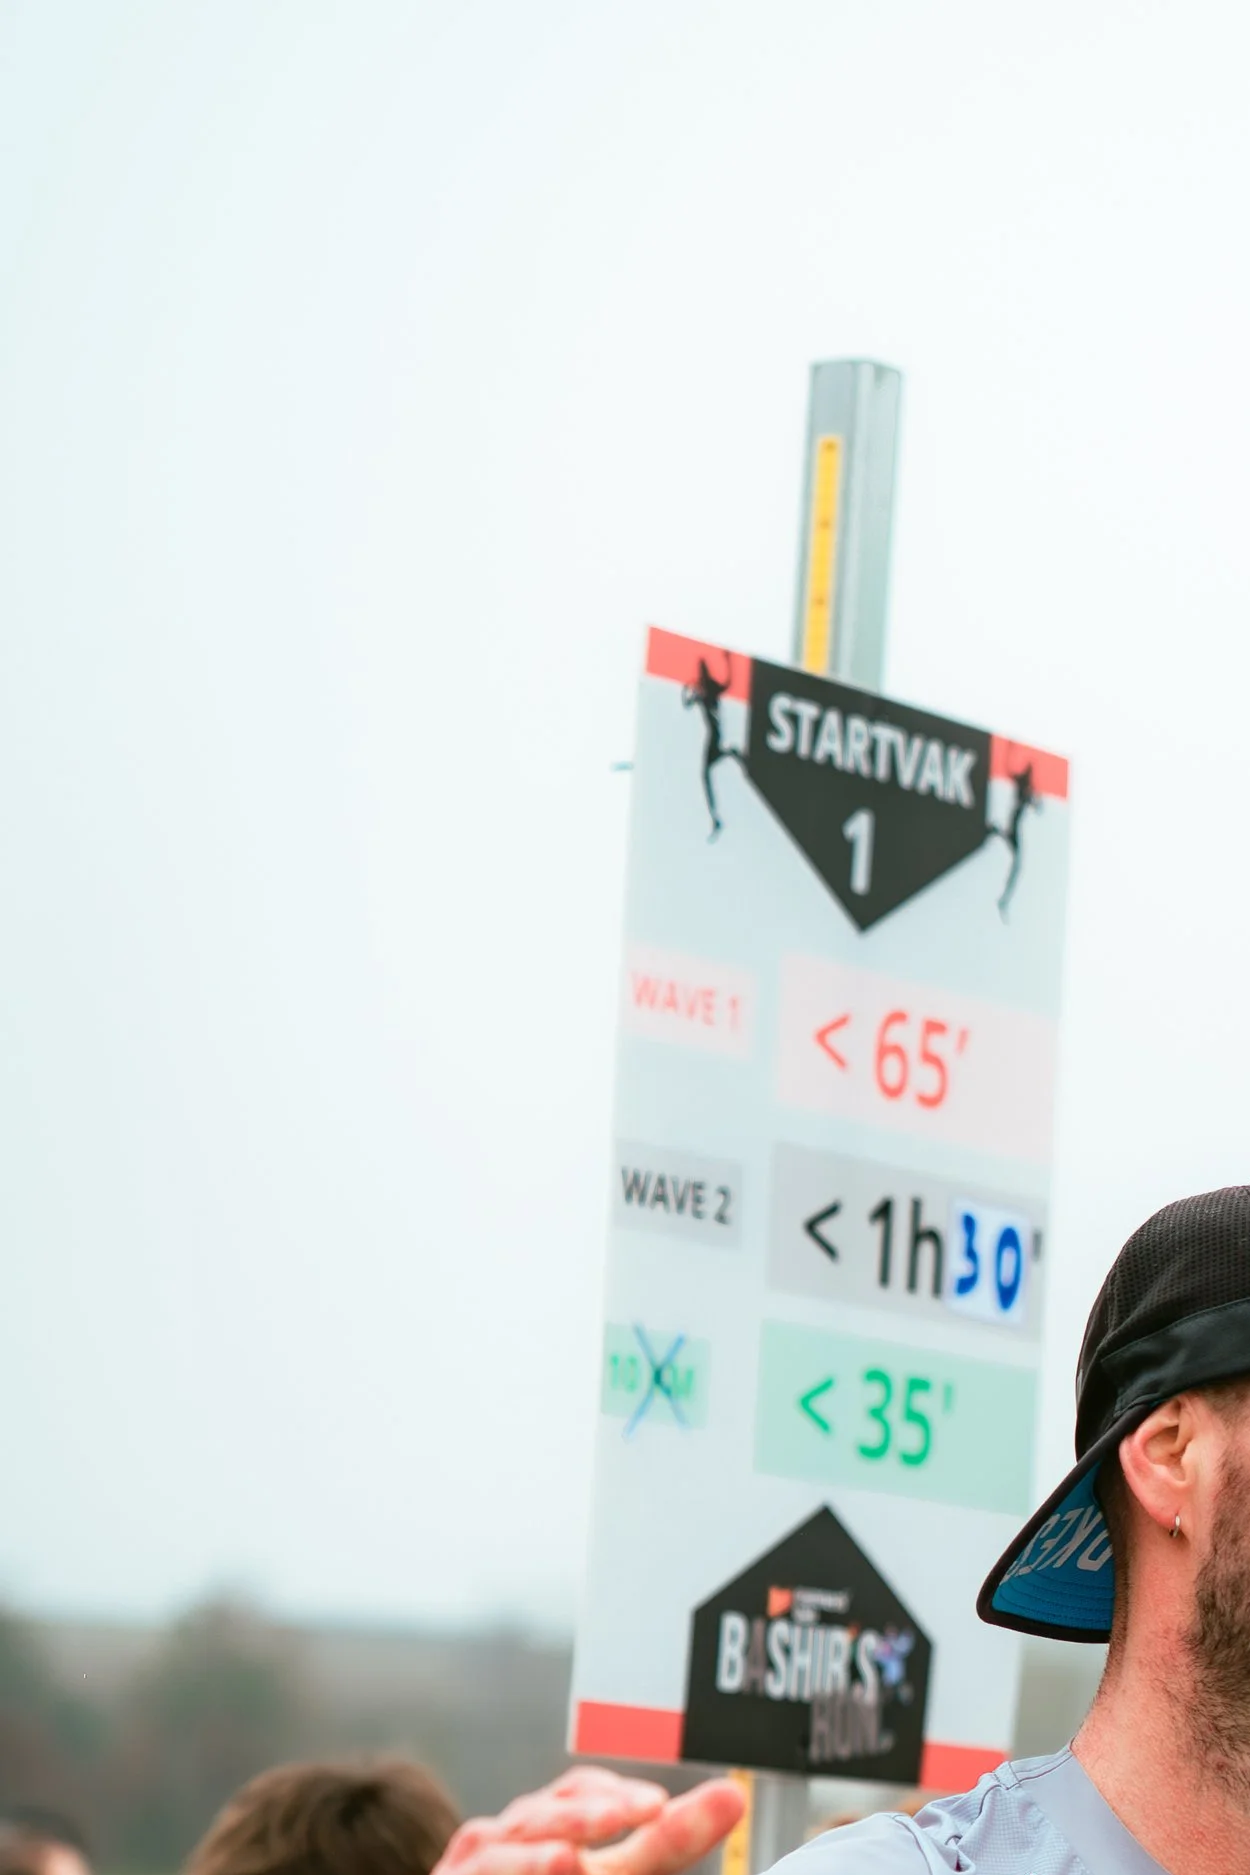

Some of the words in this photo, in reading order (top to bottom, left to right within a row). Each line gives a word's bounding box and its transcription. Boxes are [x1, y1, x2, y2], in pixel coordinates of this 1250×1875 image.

[767, 692, 976, 808] STARTVAK
[842, 808, 875, 896] 1
[630, 970, 717, 1027] WAVE
[621, 1166, 707, 1221] WAVE
[714, 1188, 732, 1226] 2
